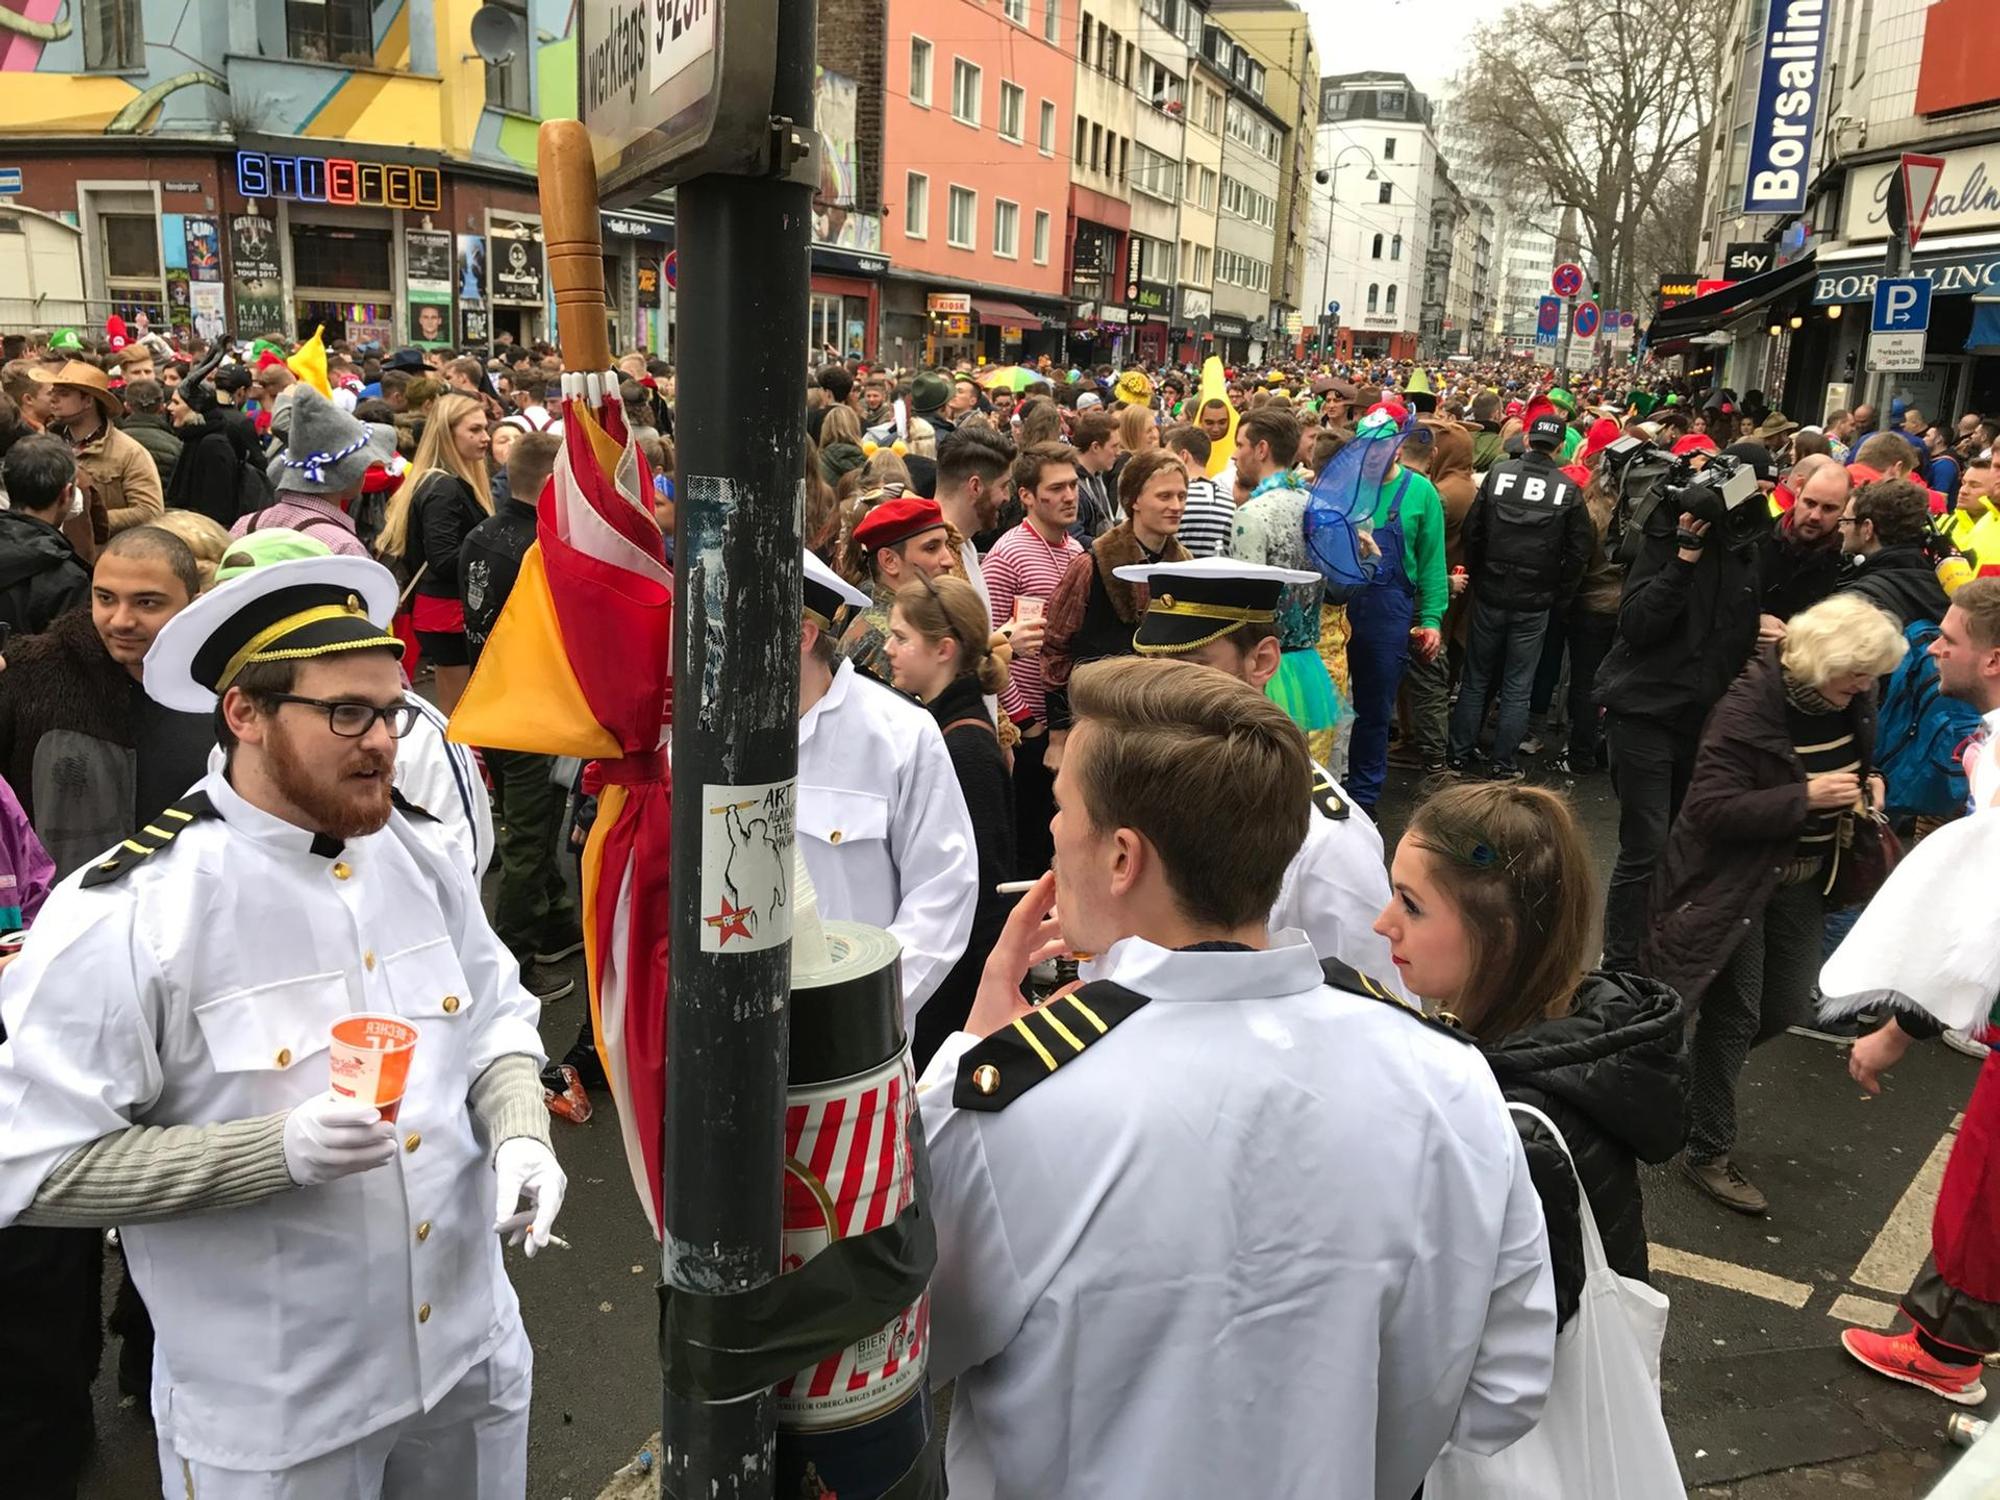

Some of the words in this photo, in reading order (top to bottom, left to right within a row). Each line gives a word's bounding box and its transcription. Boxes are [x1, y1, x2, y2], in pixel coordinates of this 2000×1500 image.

[588, 2, 646, 113] werktags
[242, 157, 437, 206] STIEFEL
[1730, 252, 1768, 272] sky
[940, 301, 965, 311] KIOSK
[1129, 311, 1146, 322] sky
[1538, 333, 1556, 346] TAXI
[1537, 421, 1560, 434] SWAT
[1493, 473, 1567, 505] FBI
[763, 783, 794, 809] ART
[772, 822, 792, 836] THE
[857, 1332, 888, 1353] BIER
[871, 1385, 887, 1398] BIER
